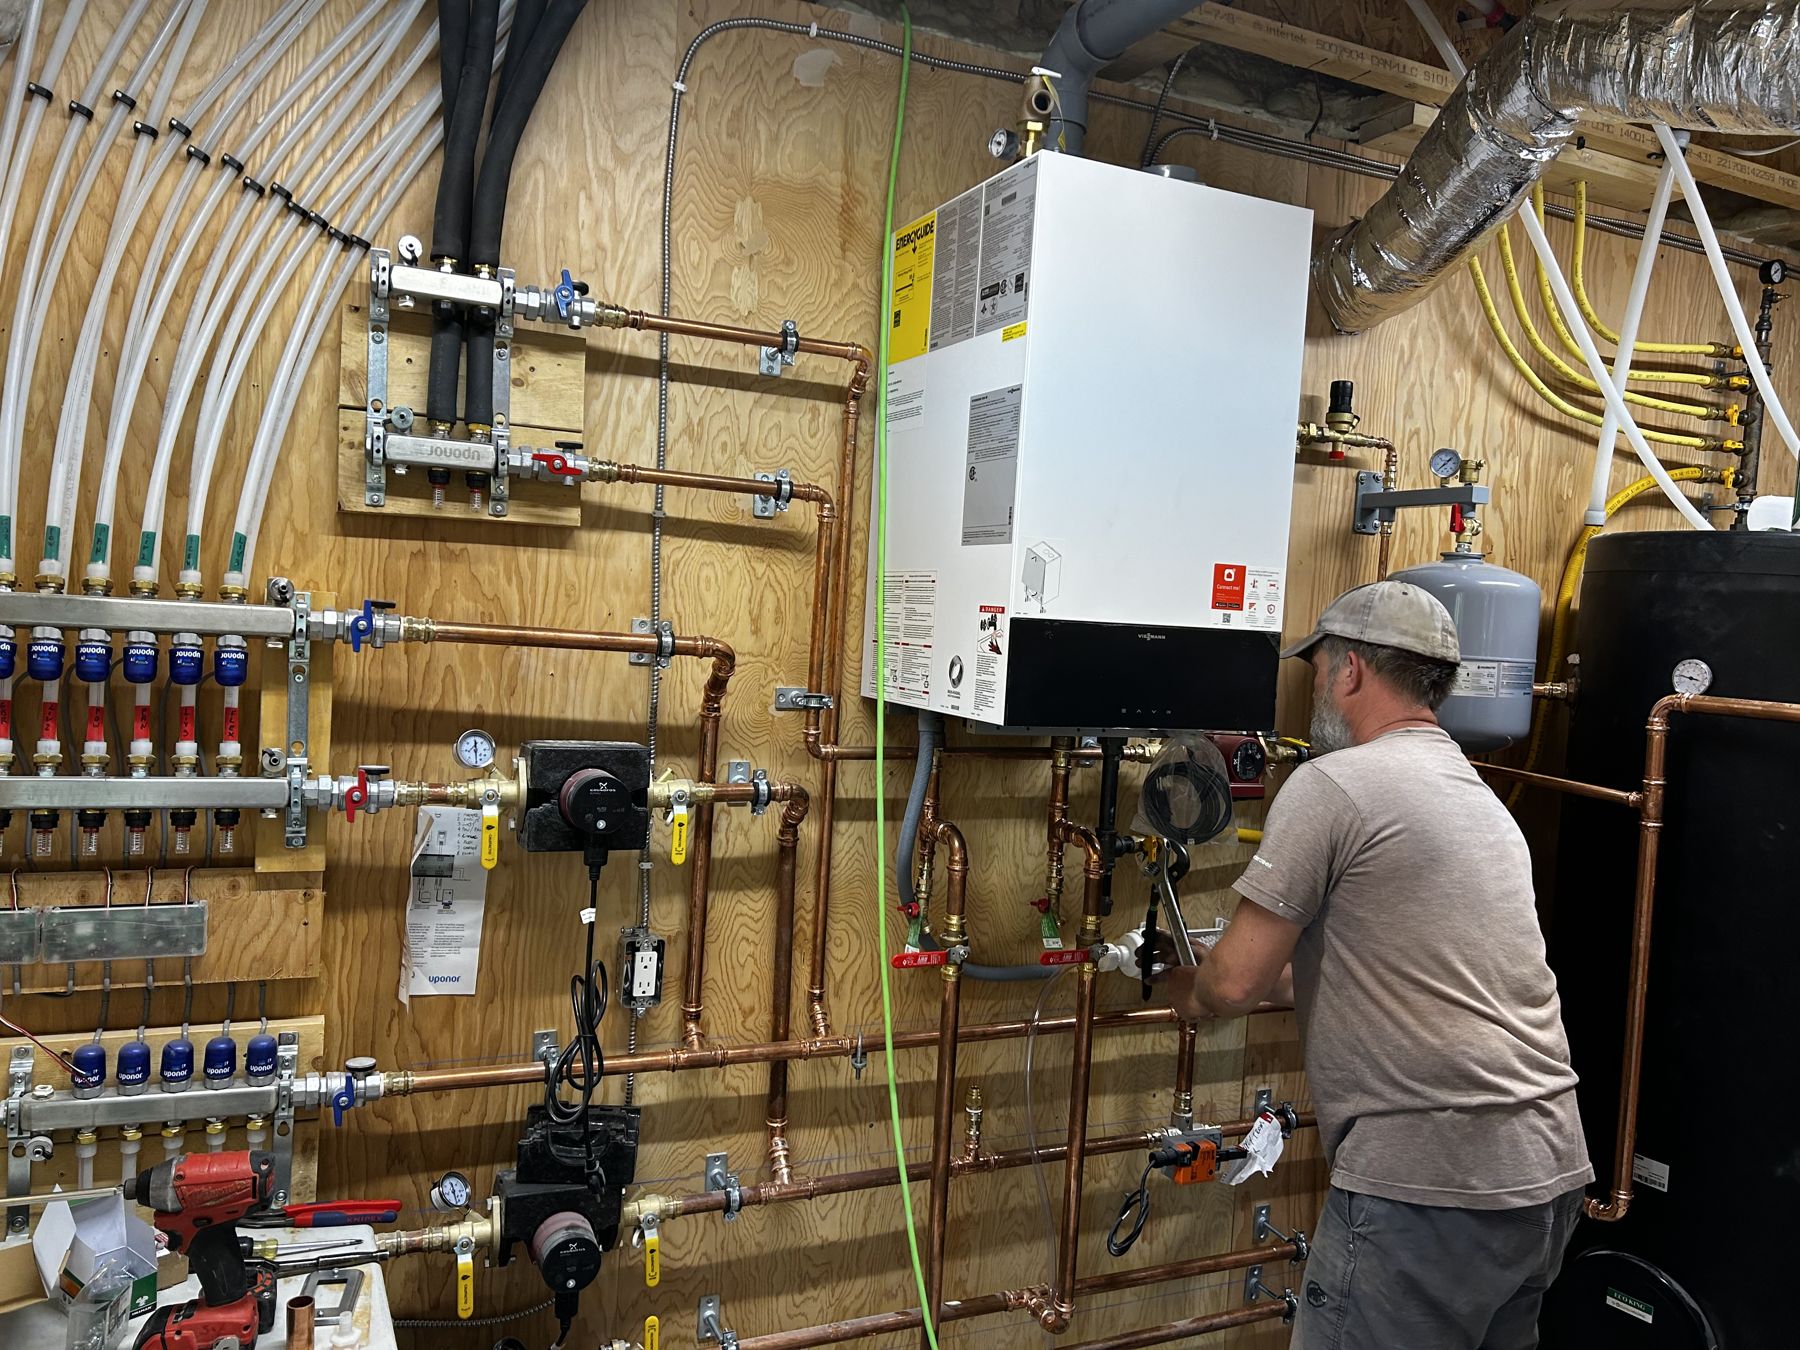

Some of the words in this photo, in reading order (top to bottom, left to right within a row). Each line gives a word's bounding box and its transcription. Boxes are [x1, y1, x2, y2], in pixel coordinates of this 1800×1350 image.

[896, 220, 934, 252] ENERGYGUIDE
[428, 446, 480, 462] uponor
[31, 644, 58, 652] uponor
[129, 648, 155, 656] uponor
[428, 974, 461, 984] uponor
[207, 1067, 231, 1076] uponor
[250, 1064, 274, 1073] uponor
[119, 1072, 143, 1082] uponor
[164, 1069, 188, 1078] uponor
